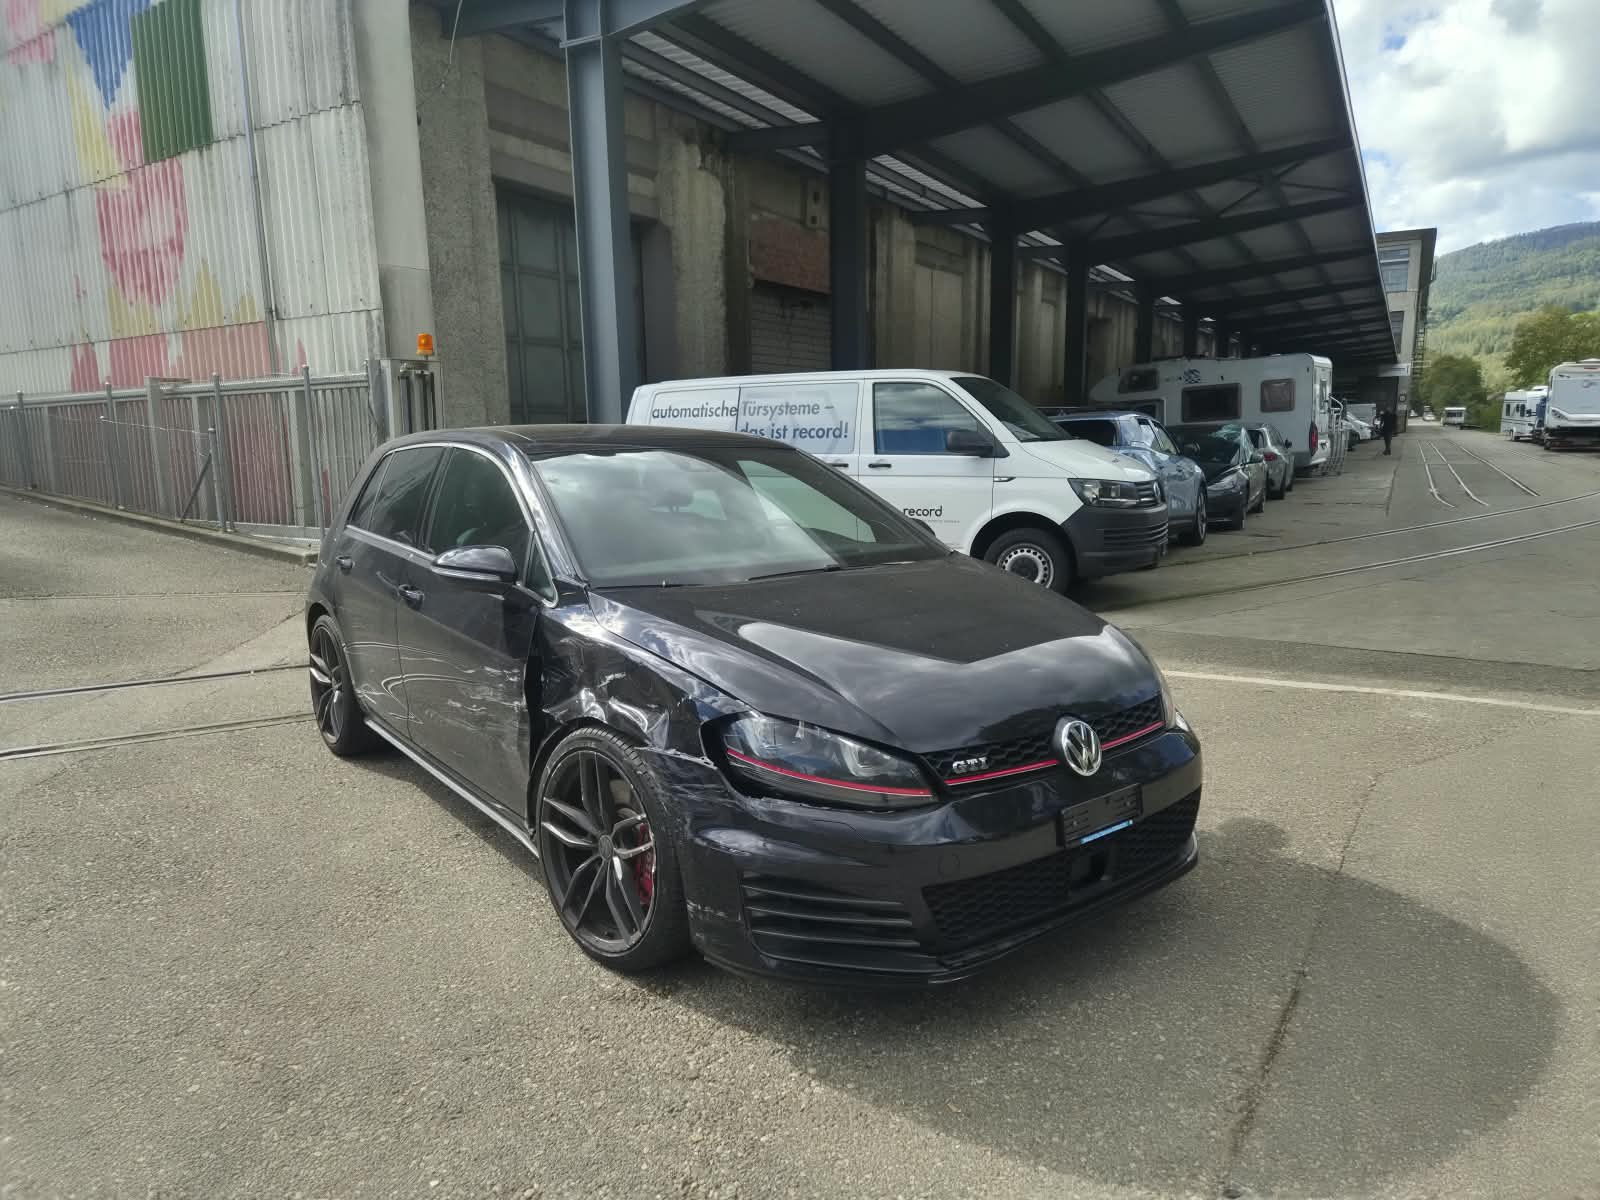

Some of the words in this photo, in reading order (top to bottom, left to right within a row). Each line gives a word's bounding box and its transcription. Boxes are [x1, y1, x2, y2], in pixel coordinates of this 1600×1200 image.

[652, 400, 738, 418] automatische
[742, 400, 820, 420] Türsysteme
[770, 423, 788, 439] ist
[792, 420, 849, 439] record!
[903, 504, 943, 517] record
[952, 756, 989, 774] GTI
